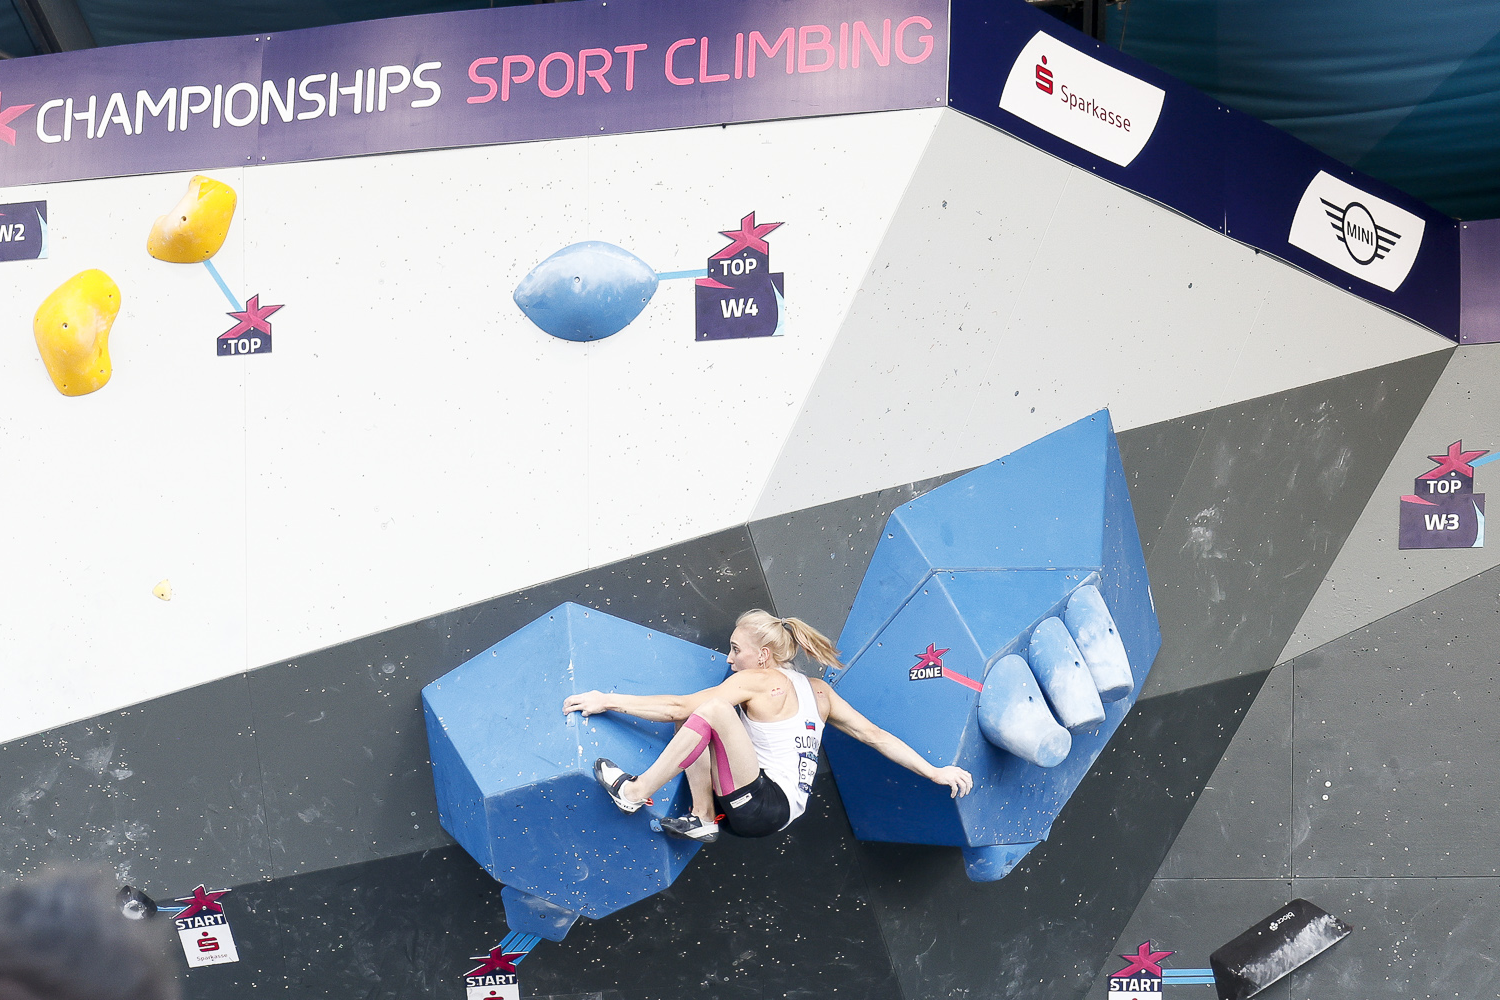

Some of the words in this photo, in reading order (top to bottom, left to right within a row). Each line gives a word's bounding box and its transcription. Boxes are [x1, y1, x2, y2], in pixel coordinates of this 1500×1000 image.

[36, 61, 442, 144] CHAMPIONSHIPS
[467, 43, 648, 104] SPORT
[665, 16, 934, 86] CLIMBING
[1061, 85, 1131, 132] Sparkasse
[1347, 220, 1373, 247] MINI
[720, 258, 757, 276] TOP
[721, 297, 759, 318] W4
[228, 338, 262, 355] TOP
[1426, 480, 1462, 494] TOP
[1424, 513, 1460, 531] W3
[911, 666, 941, 680] ZONE
[175, 913, 224, 930] START
[197, 953, 228, 962] Sparkasse
[465, 974, 516, 987] START
[1110, 978, 1161, 992] START
